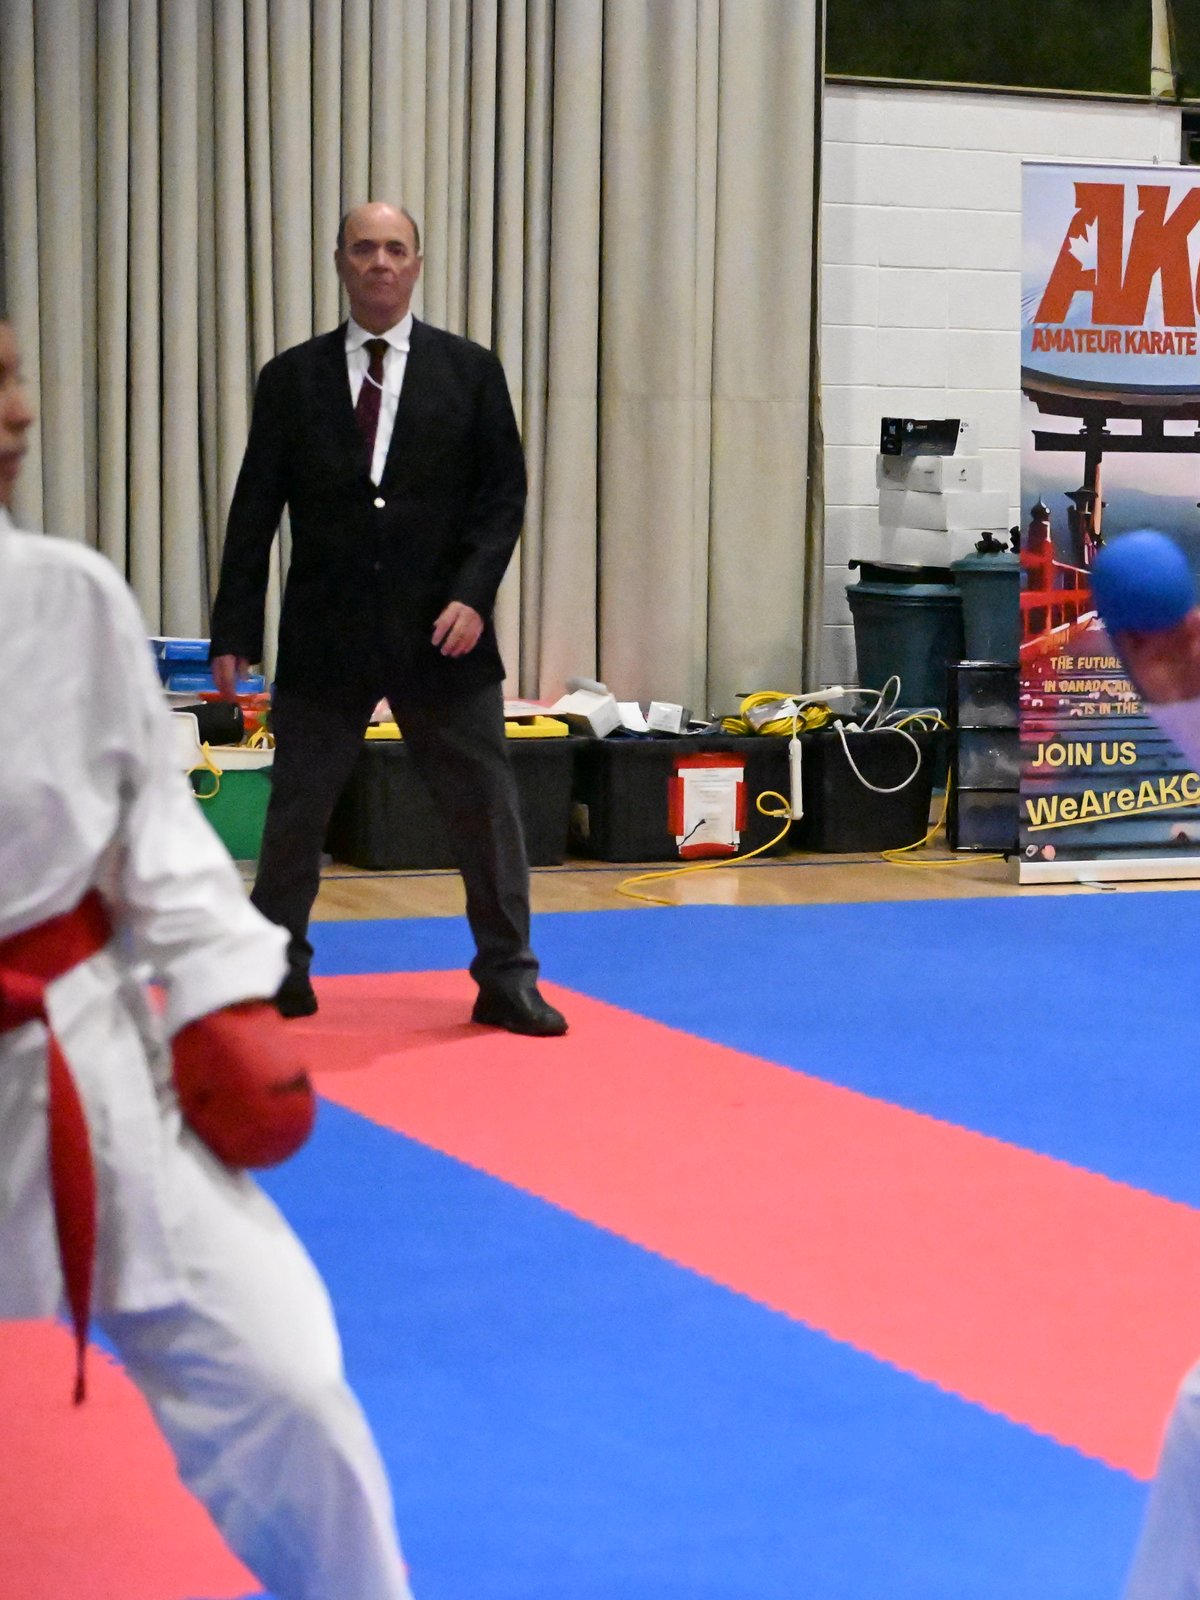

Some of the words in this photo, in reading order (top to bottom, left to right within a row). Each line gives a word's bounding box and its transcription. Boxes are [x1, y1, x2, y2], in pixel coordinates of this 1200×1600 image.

[1031, 328, 1121, 354] AMATEUR
[1124, 330, 1197, 356] KARATE
[1050, 657, 1073, 670] THE
[1044, 680, 1056, 693] IN
[1060, 680, 1109, 693] CANADA
[1084, 703, 1095, 715] IS
[1100, 703, 1110, 715] IN
[1116, 702, 1139, 714] THE
[1032, 742, 1092, 767] JOIN
[1101, 741, 1137, 765] US
